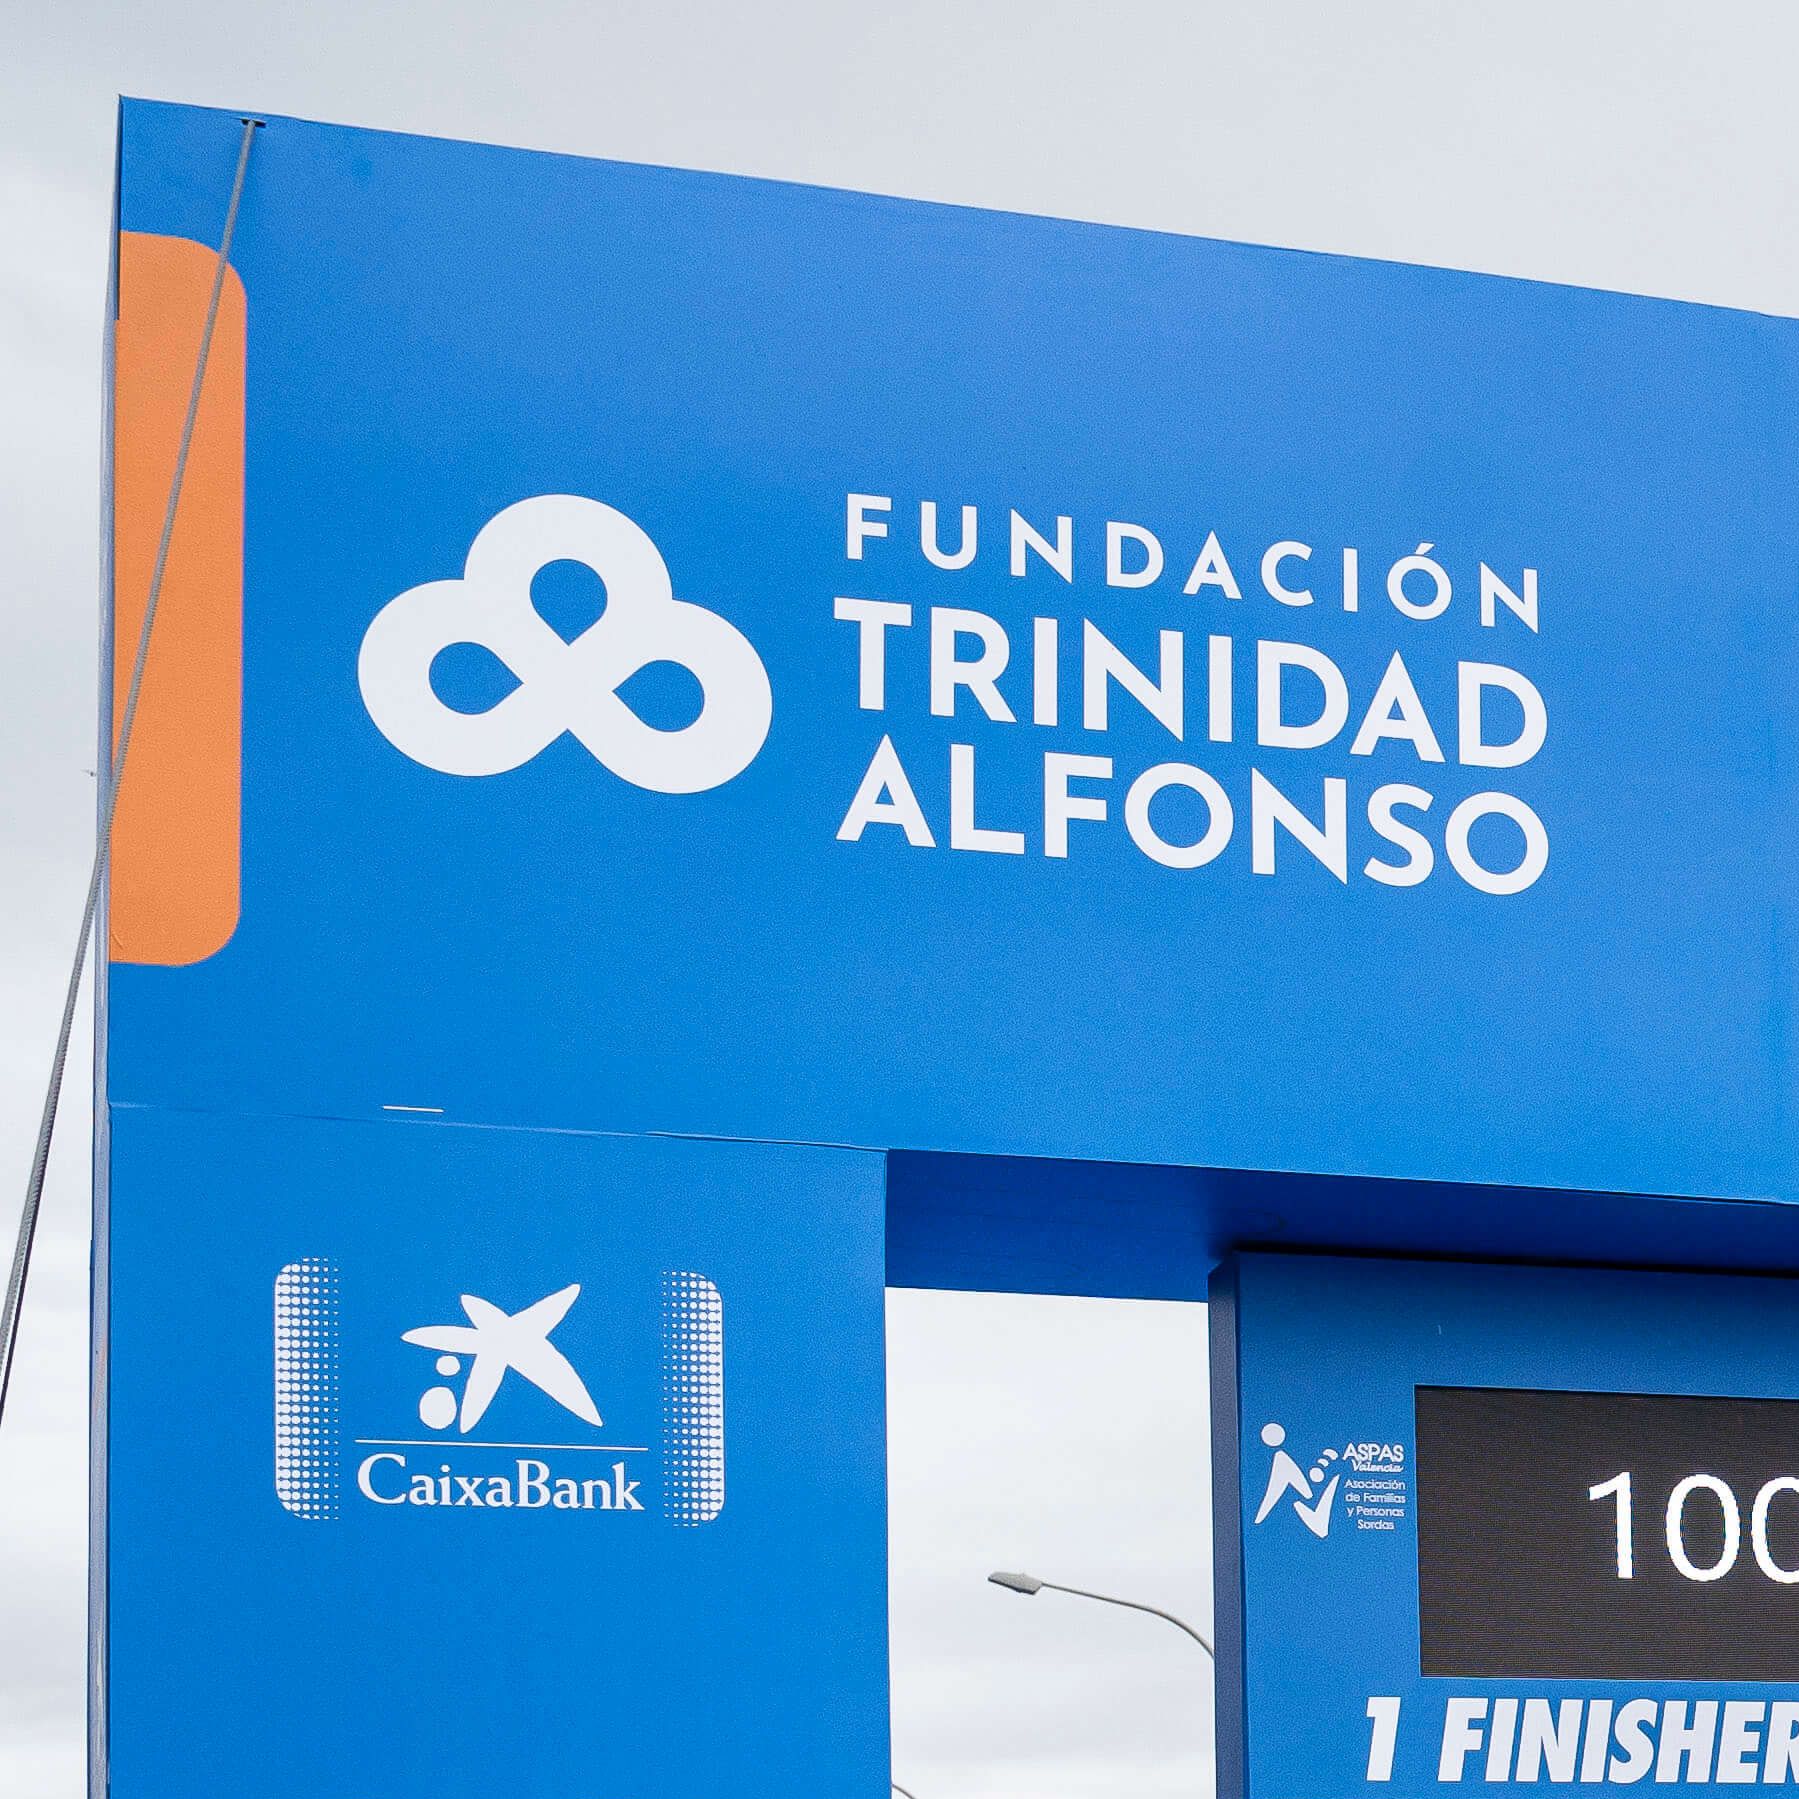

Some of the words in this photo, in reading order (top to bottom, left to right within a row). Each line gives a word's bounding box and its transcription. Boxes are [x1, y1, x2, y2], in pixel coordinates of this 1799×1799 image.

[846, 491, 1544, 634] FUNDACIÓN
[834, 597, 1549, 770] TRINIDAD
[836, 735, 1549, 896] ALFONSO
[356, 1453, 646, 1511] CaixaBank
[1342, 1442, 1405, 1463] ASPAS
[1366, 1695, 1402, 1782] 1
